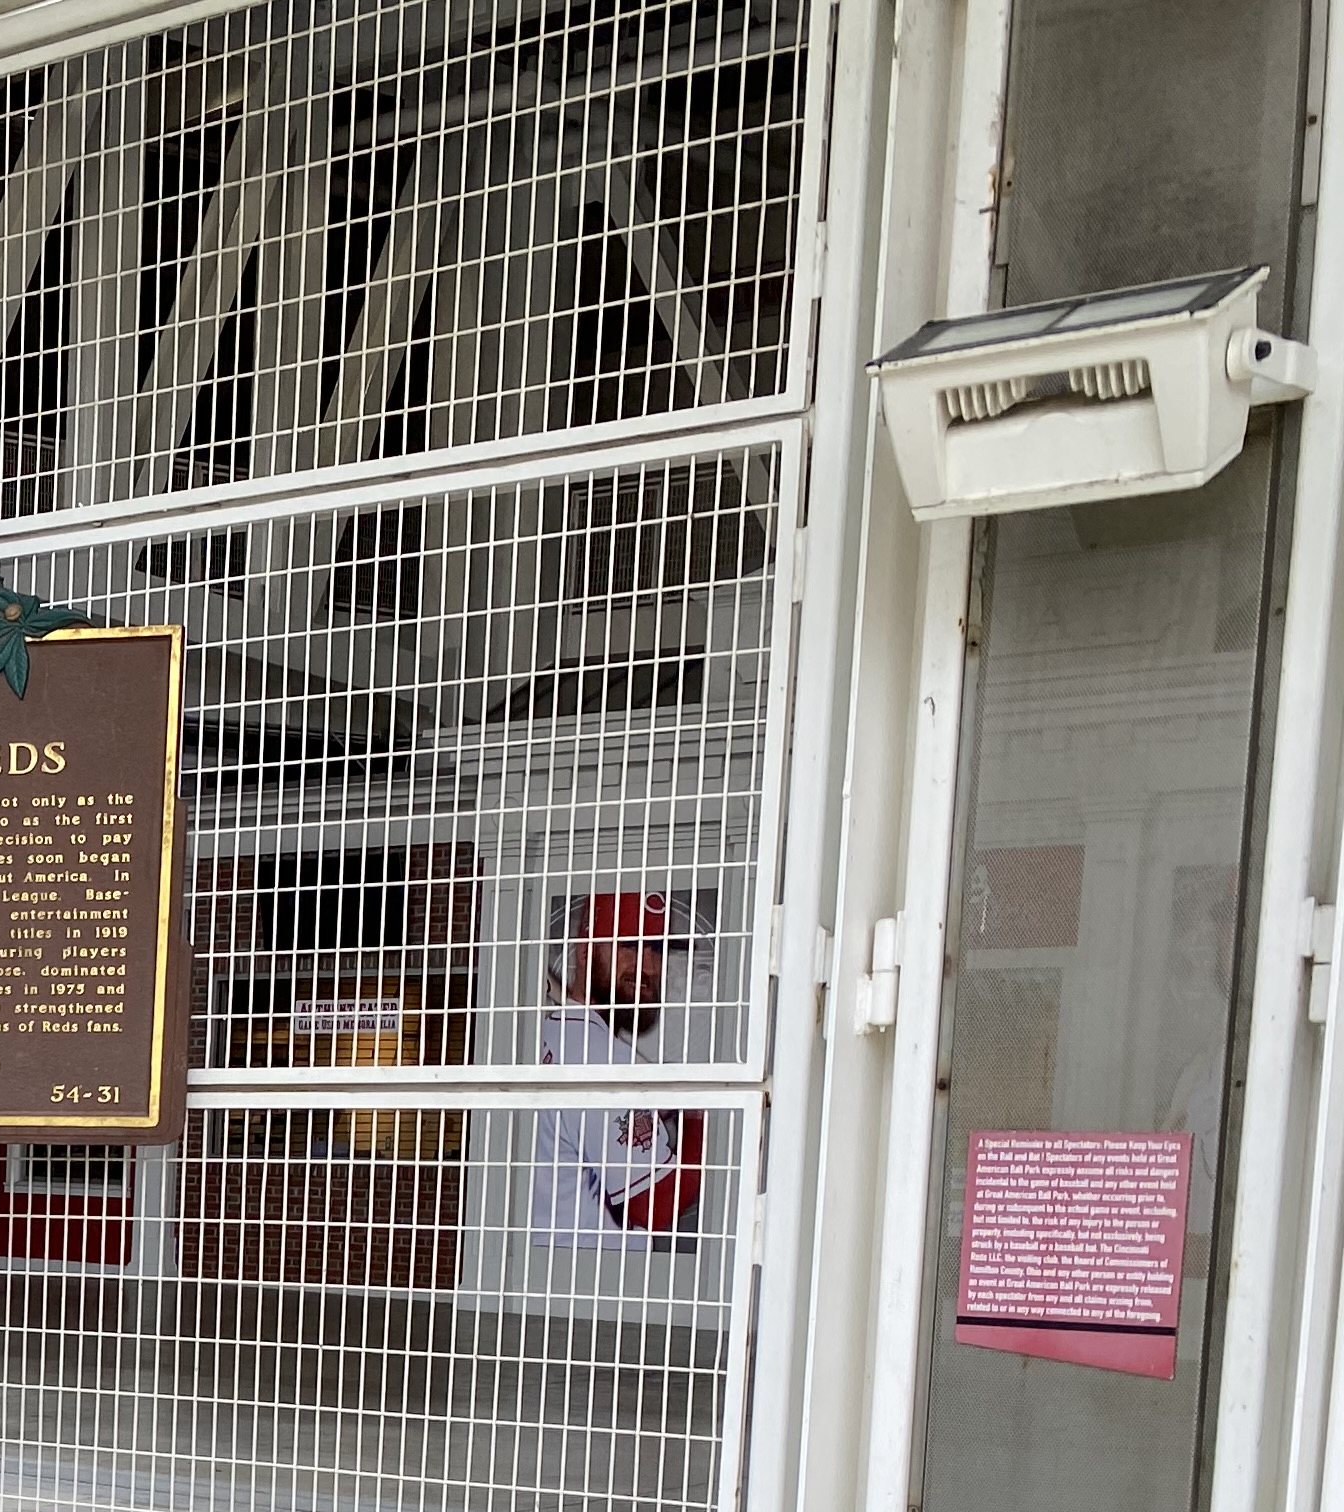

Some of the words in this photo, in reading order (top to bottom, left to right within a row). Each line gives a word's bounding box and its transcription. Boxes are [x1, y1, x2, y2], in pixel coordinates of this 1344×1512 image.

[31, 794, 66, 808] only
[77, 795, 94, 805] as
[107, 793, 133, 804] the
[22, 816, 39, 825] as
[54, 813, 80, 825] the
[95, 812, 132, 824] first
[70, 833, 86, 844] to
[102, 833, 131, 845] pay
[27, 854, 63, 863] soon
[78, 850, 130, 865] began
[23, 870, 91, 882] America.
[114, 869, 129, 881] In
[10, 907, 127, 920] entertainment
[10, 927, 51, 939] titles
[66, 926, 80, 938] in
[95, 926, 127, 938] 1919
[62, 945, 126, 959] players
[24, 983, 37, 994] in
[50, 983, 84, 994] 1975
[96, 983, 124, 994] and
[14, 1001, 123, 1016] strengthened
[18, 1020, 34, 1032] of
[42, 1020, 78, 1032] Reds
[86, 1020, 122, 1032] fans.
[50, 1084, 119, 1103] 54-31
